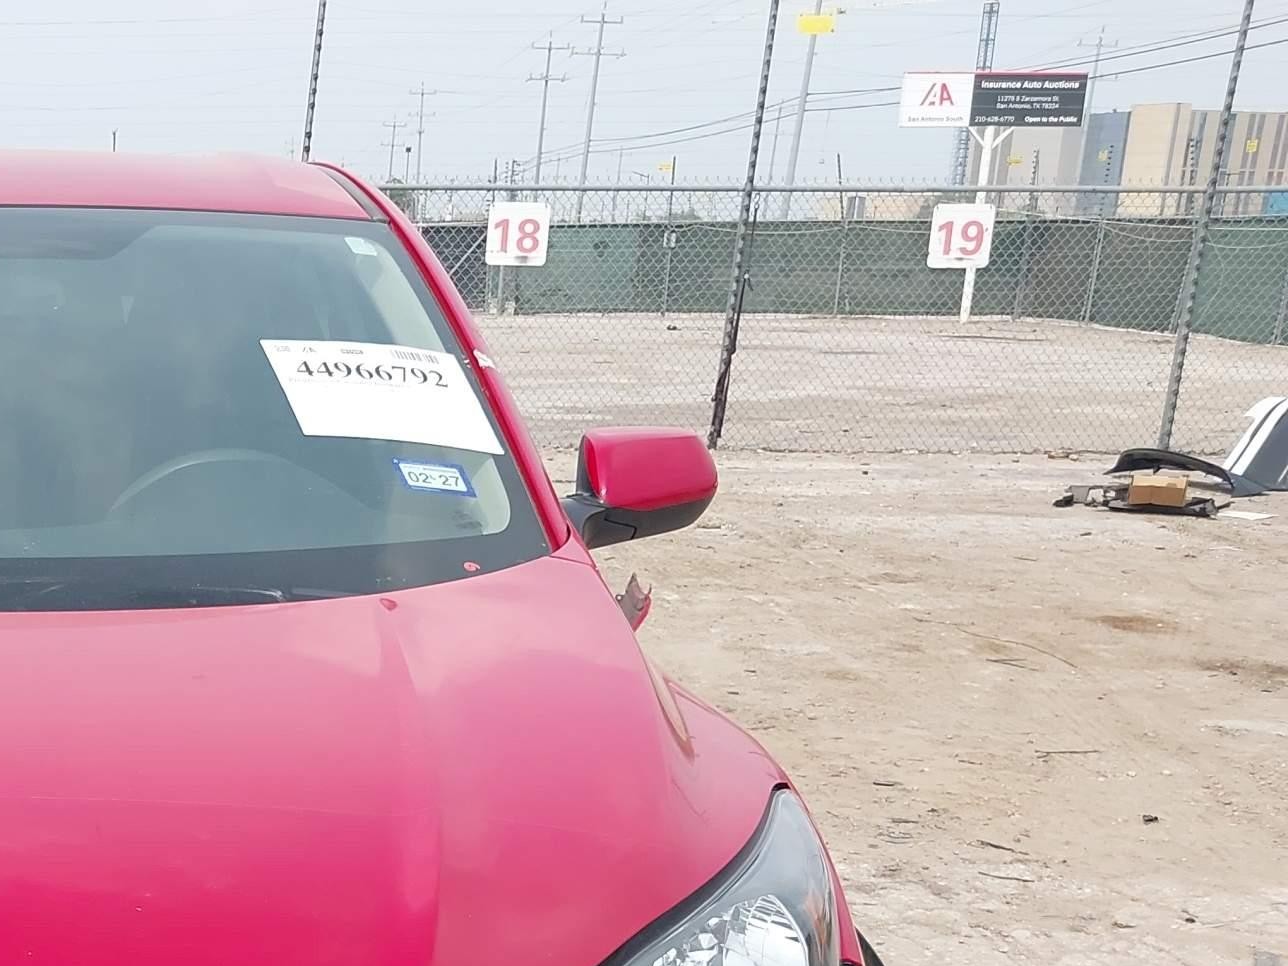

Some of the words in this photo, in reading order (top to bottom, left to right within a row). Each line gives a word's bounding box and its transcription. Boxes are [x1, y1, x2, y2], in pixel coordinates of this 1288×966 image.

[981, 80, 1021, 89] Insurance
[1022, 80, 1042, 89] Auto
[1043, 80, 1080, 89] Auctions
[494, 218, 541, 254] 18
[938, 220, 984, 256] 19
[296, 360, 449, 388] 44966792
